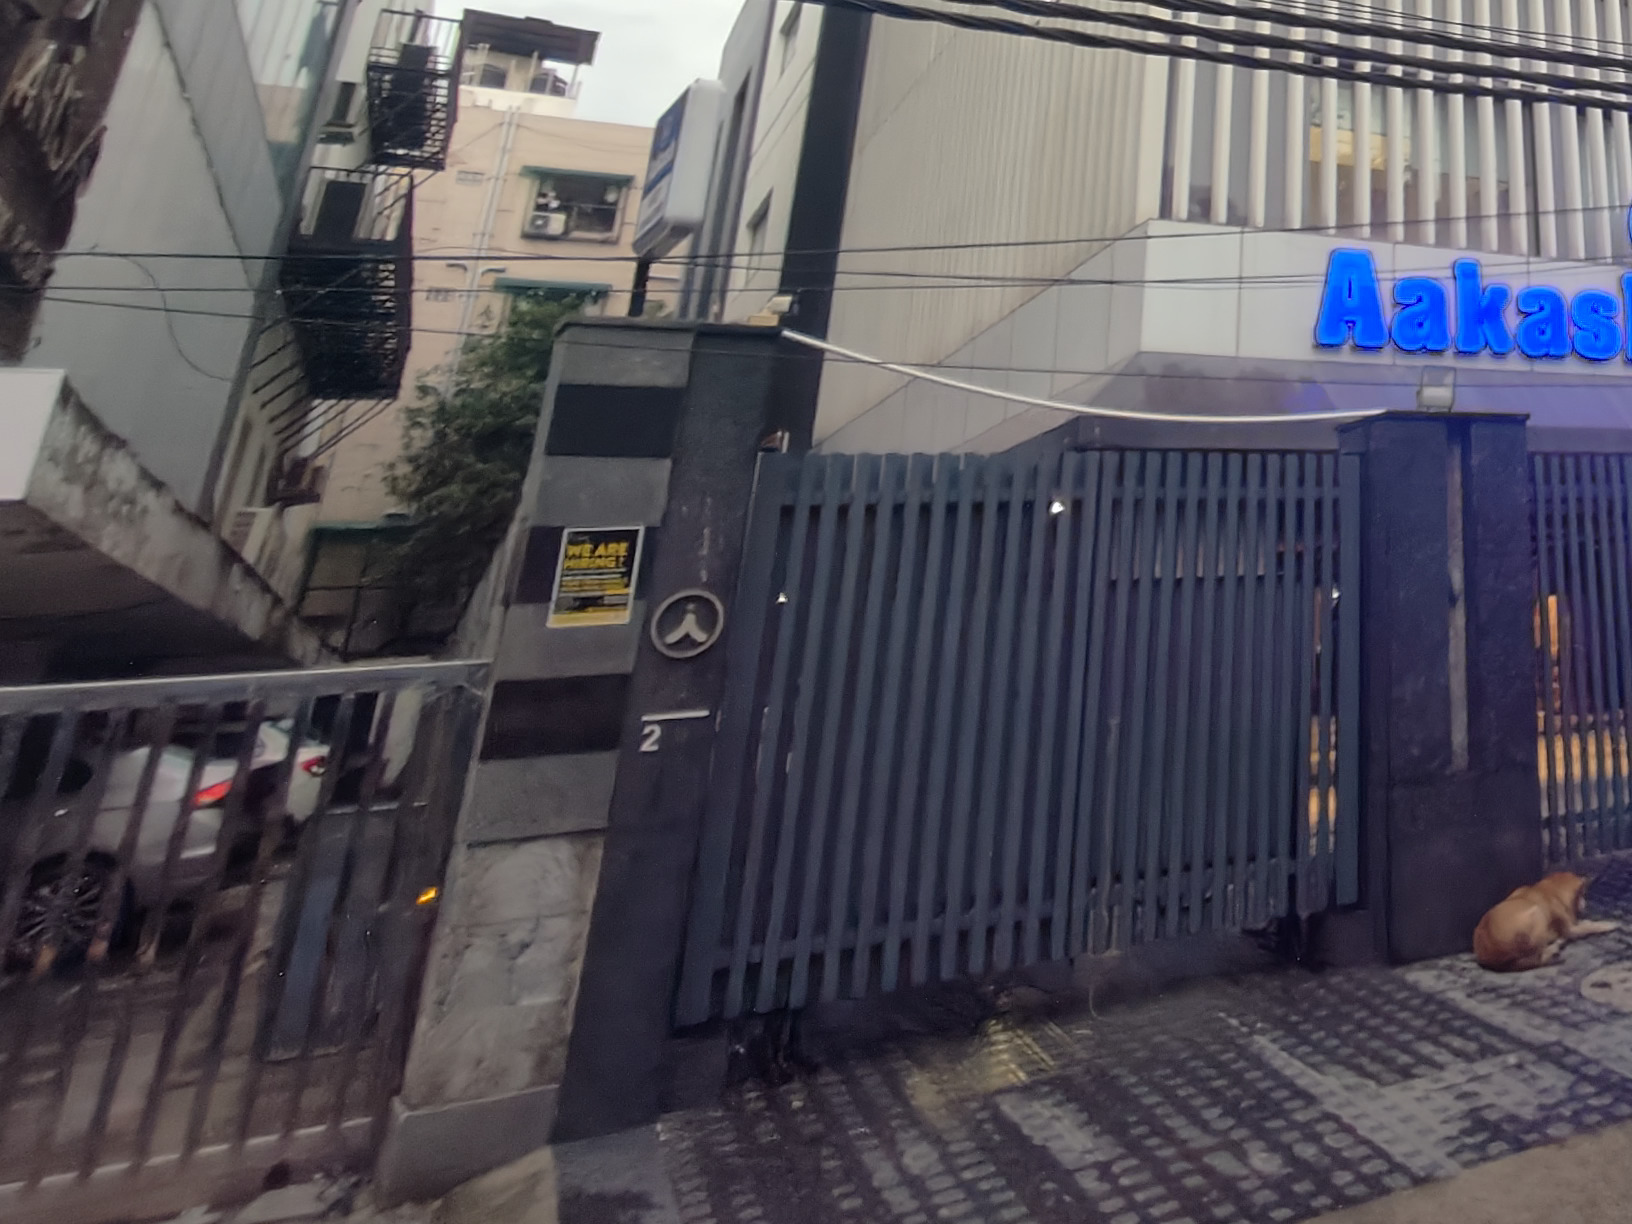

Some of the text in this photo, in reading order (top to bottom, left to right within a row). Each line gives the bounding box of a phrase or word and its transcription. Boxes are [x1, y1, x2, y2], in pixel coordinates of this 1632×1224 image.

[566, 541, 629, 558] WE ARE
[639, 724, 662, 752] 2
